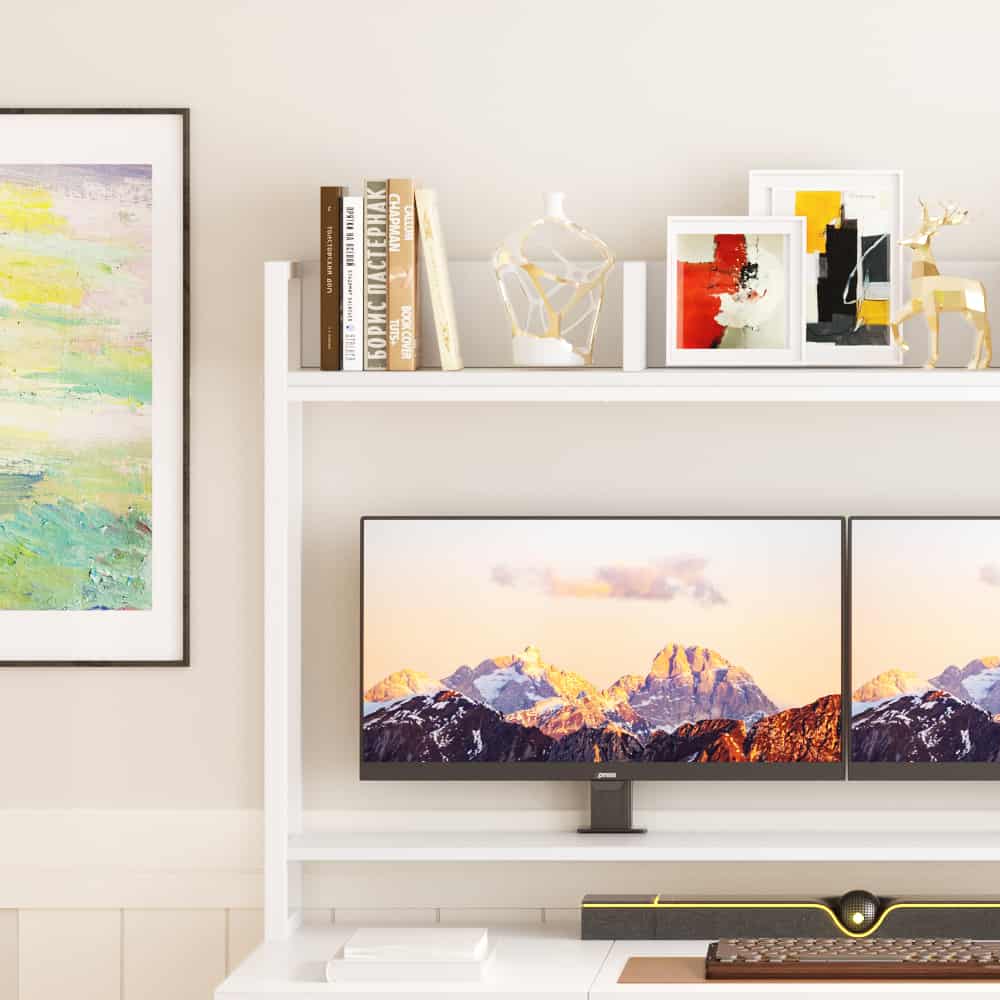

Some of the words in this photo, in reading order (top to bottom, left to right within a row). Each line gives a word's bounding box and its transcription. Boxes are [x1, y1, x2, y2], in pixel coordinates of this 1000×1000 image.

[367, 185, 387, 294] ПАСТЕРНАК
[389, 193, 400, 251] CHAPMAN
[367, 301, 387, 359] БОРИС
